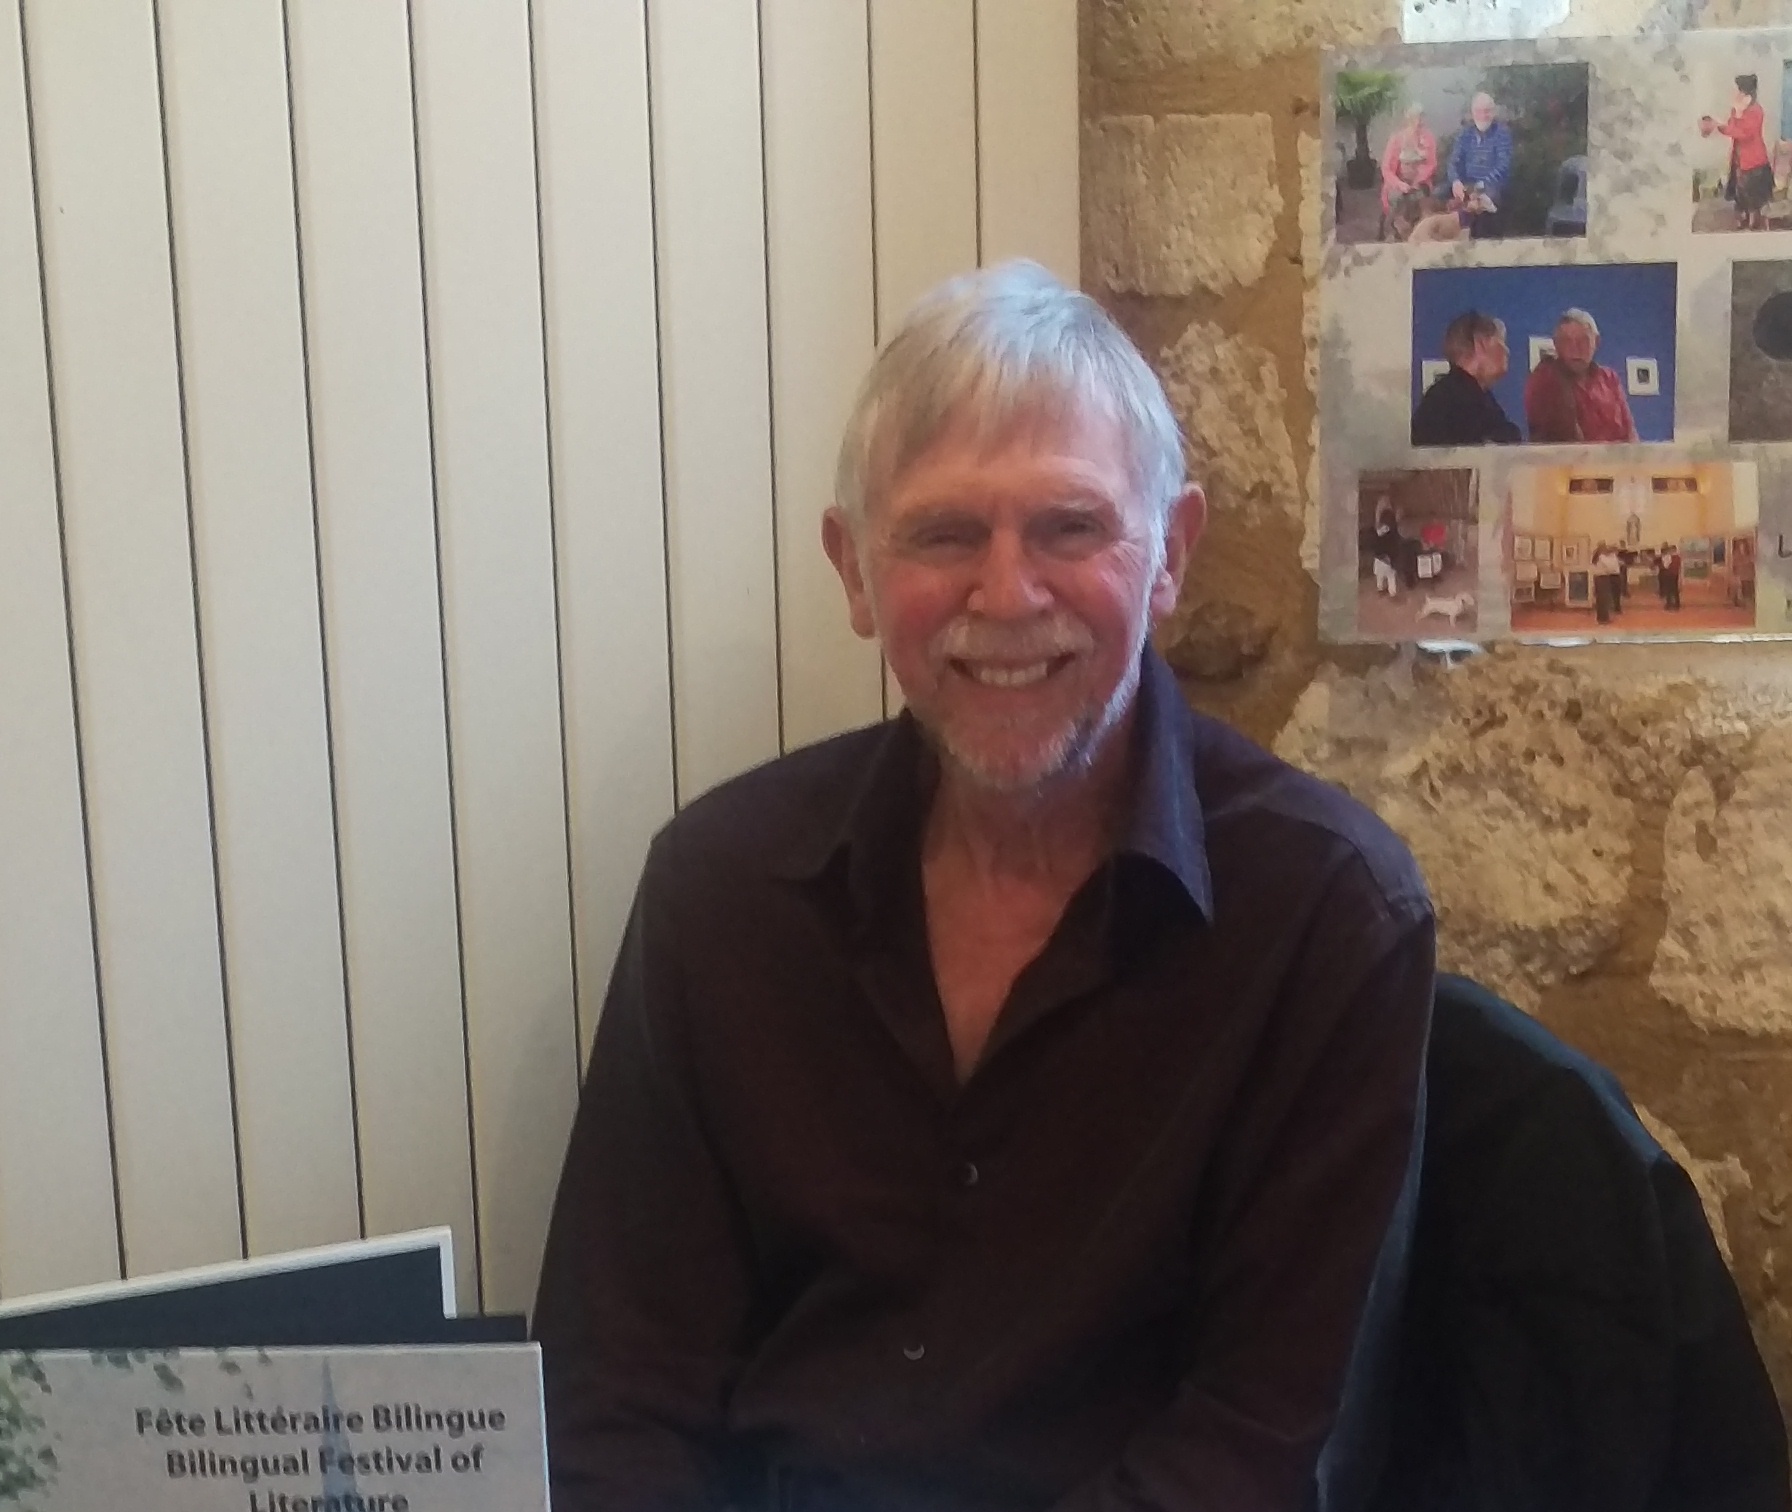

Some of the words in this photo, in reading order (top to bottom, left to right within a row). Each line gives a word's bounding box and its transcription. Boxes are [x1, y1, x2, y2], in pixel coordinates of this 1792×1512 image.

[134, 1404, 206, 1437] Fête
[214, 1404, 365, 1436] Littéraire
[372, 1402, 508, 1440] Bilingue
[166, 1447, 310, 1484] Bilingual
[318, 1444, 444, 1477] Festival
[450, 1441, 486, 1474] of
